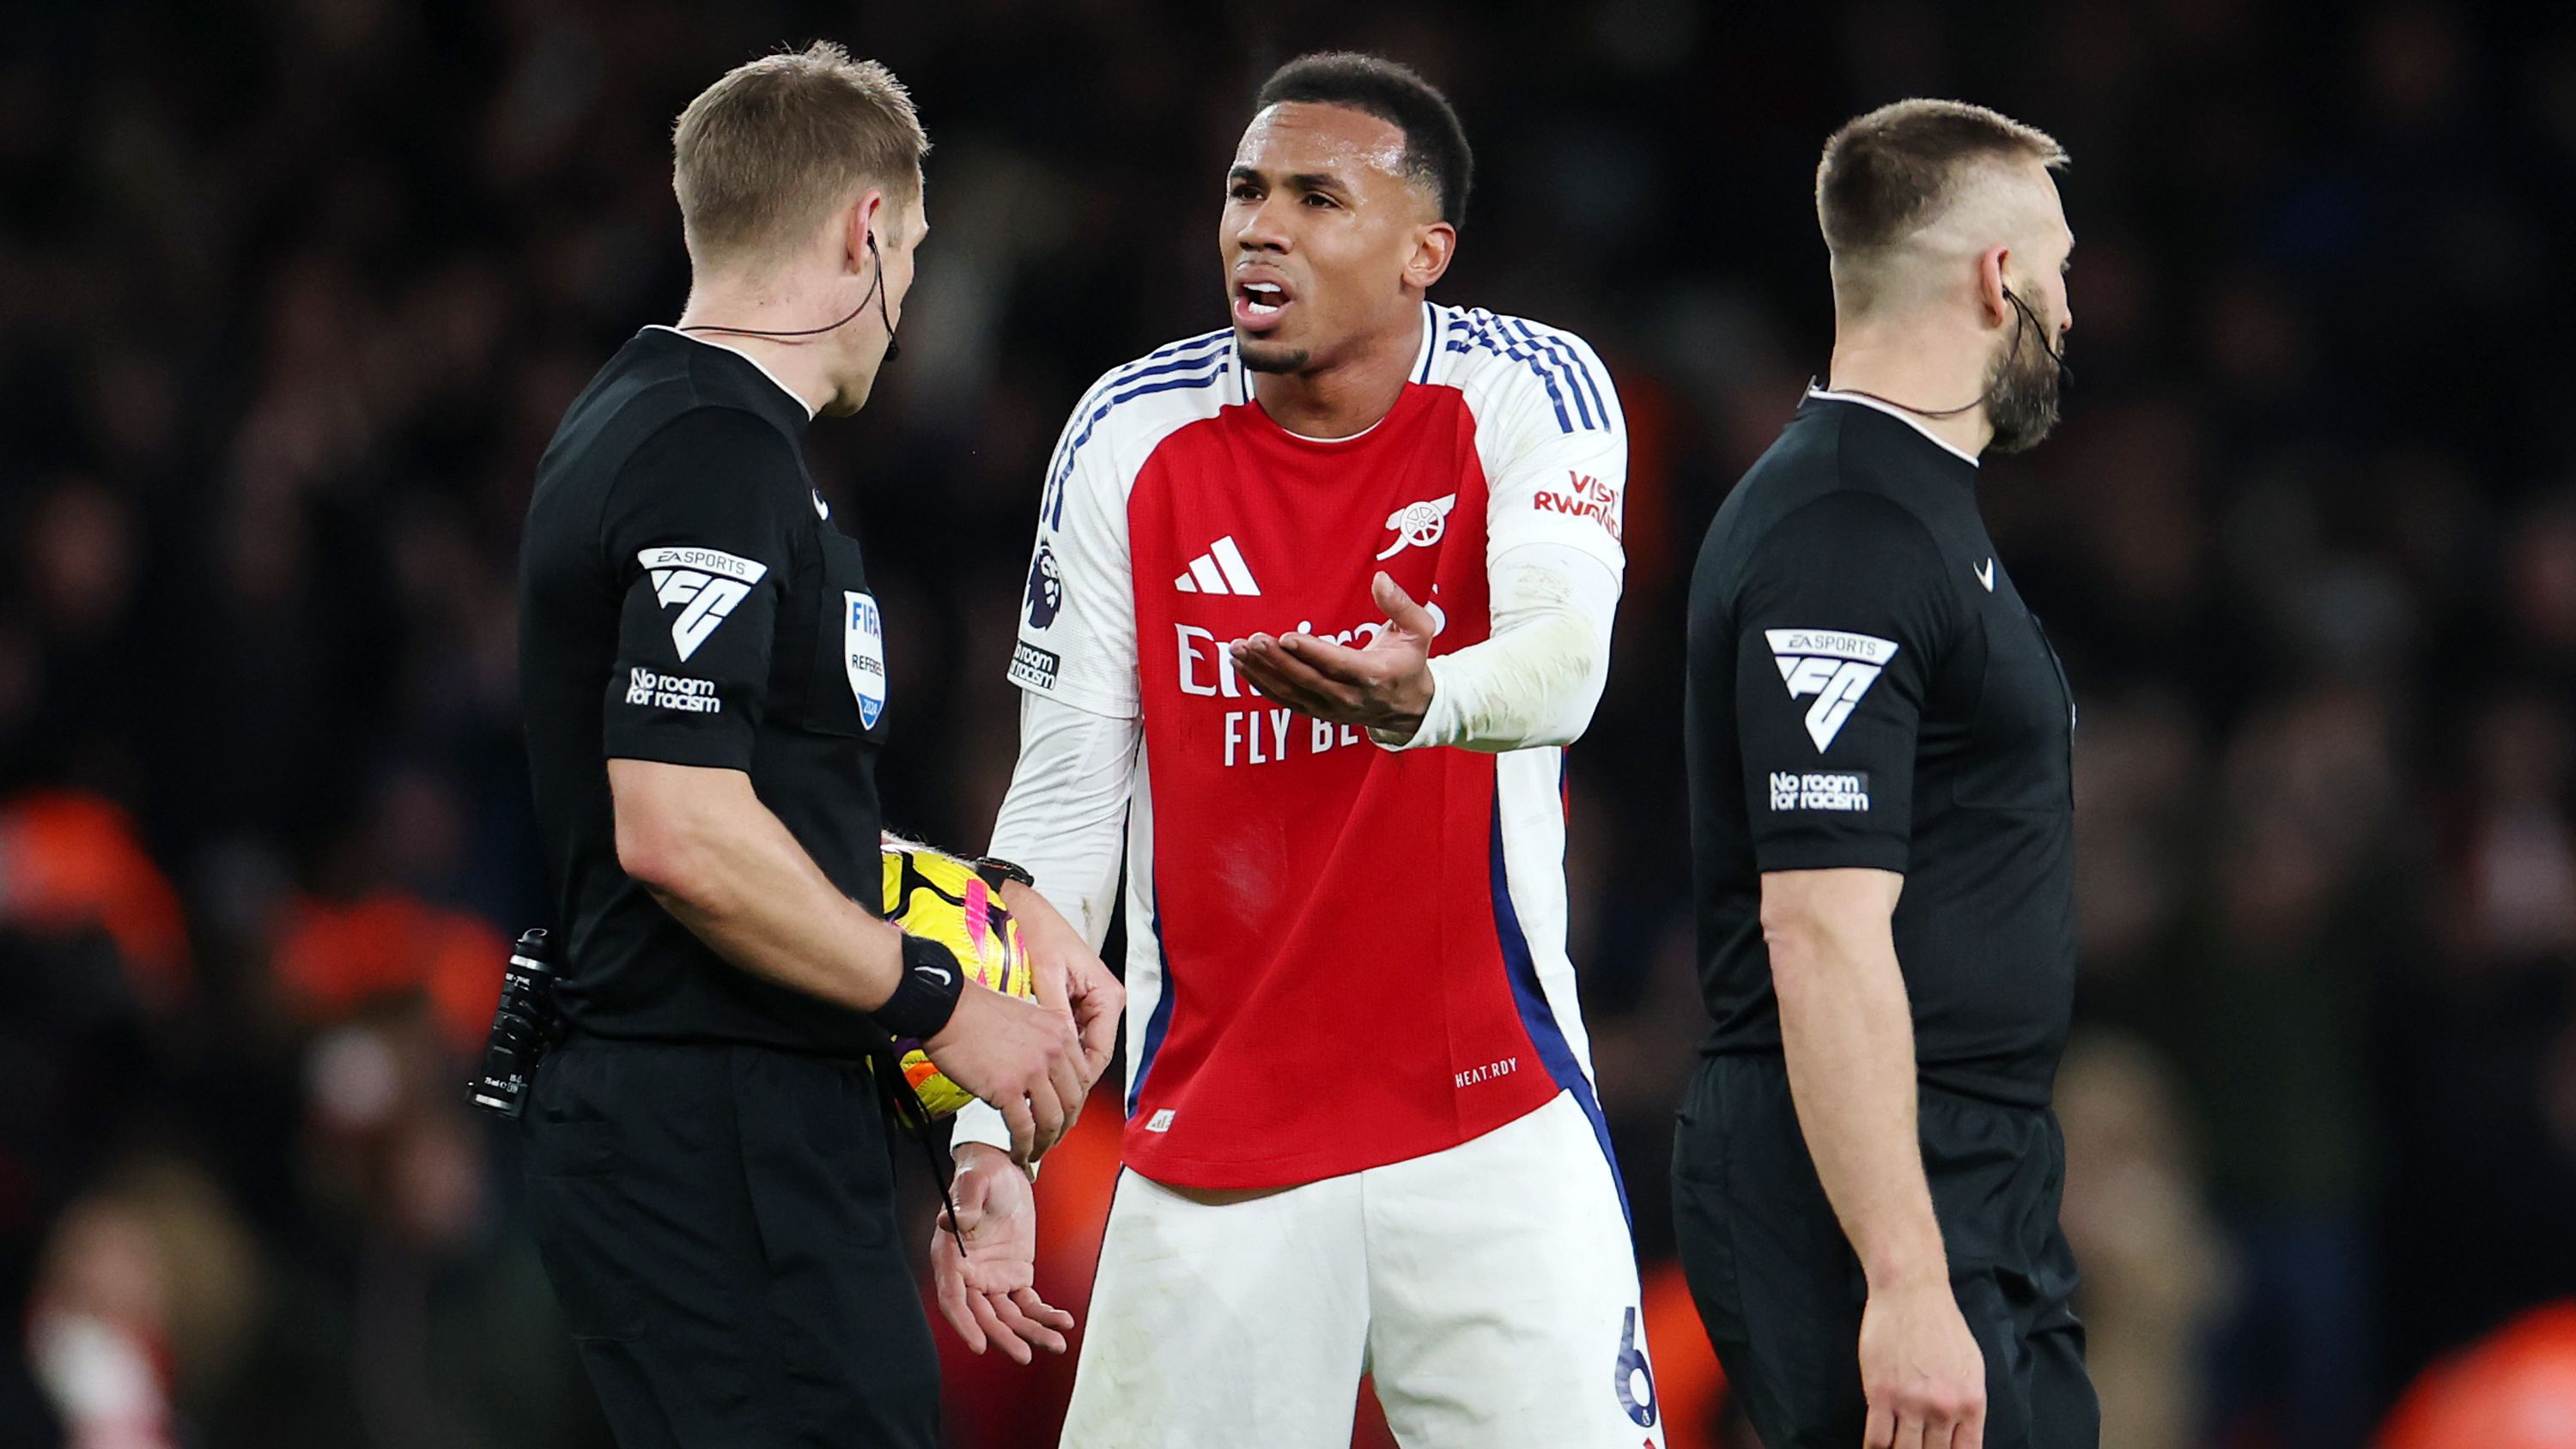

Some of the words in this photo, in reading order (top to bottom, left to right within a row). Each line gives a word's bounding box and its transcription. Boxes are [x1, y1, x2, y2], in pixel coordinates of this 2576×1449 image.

[657, 551, 681, 562] EA
[683, 551, 746, 575] SPORTS
[853, 602, 880, 640] FIFA
[1789, 634, 1813, 648] EA
[1814, 635, 1876, 657] SPORTS
[631, 667, 657, 688] No
[658, 675, 714, 696] room
[626, 685, 653, 706] for
[654, 691, 720, 713] racism
[1224, 708, 1291, 767] FLY
[1770, 771, 1800, 791] No
[1801, 774, 1859, 793] room
[1771, 790, 1799, 811] for
[1801, 791, 1869, 812] racism
[1455, 1057, 1516, 1088] HEAT.RDY
[1614, 1307, 1656, 1428] 6
